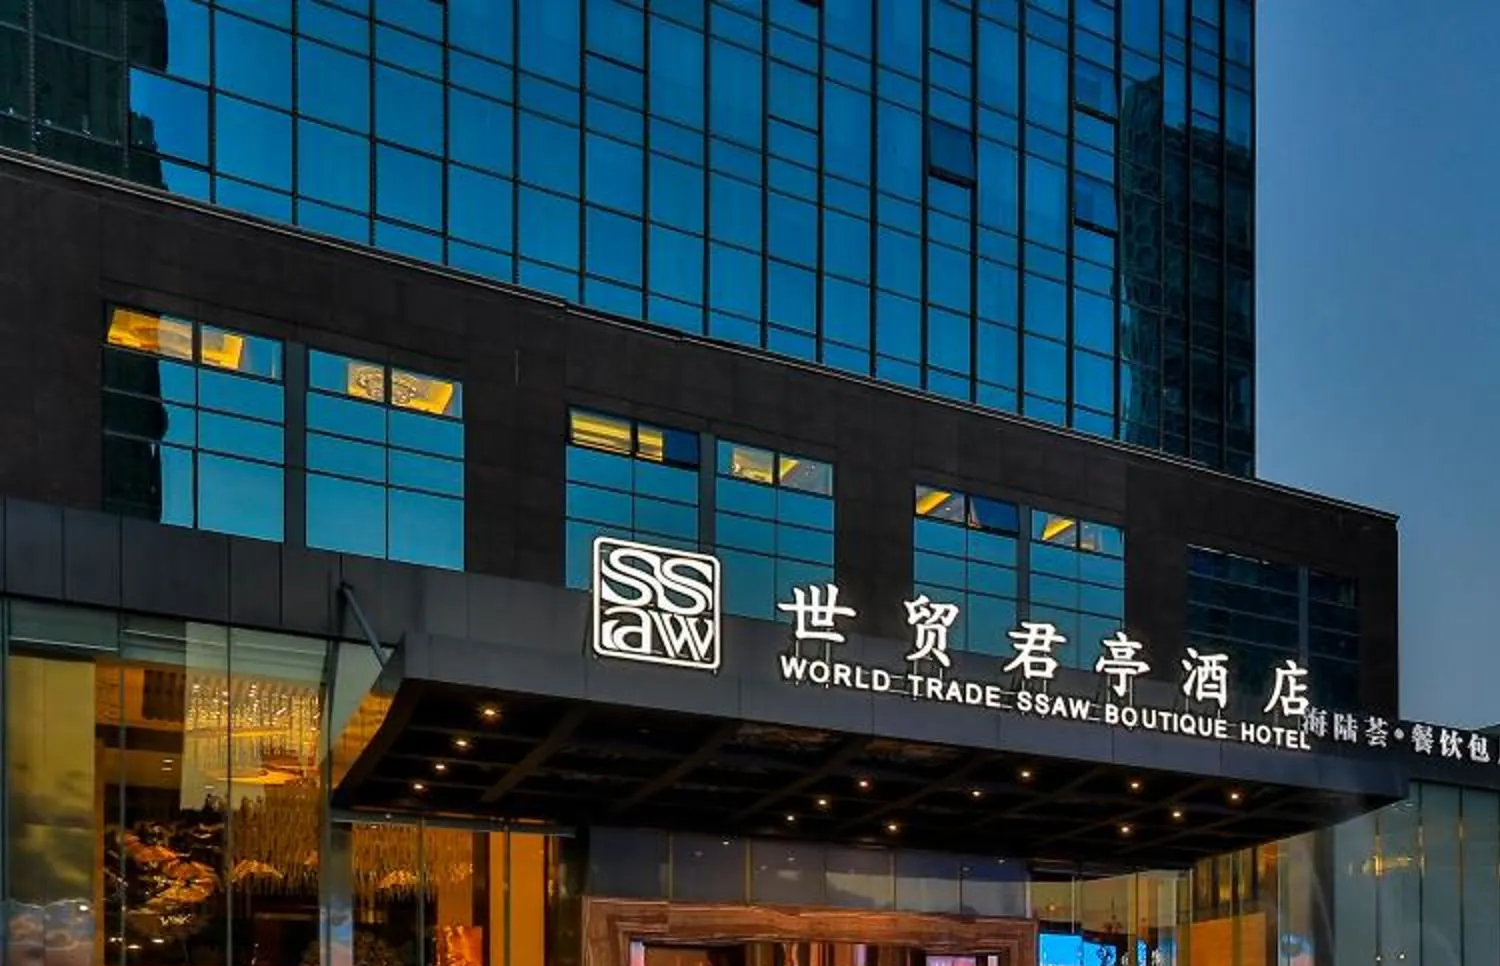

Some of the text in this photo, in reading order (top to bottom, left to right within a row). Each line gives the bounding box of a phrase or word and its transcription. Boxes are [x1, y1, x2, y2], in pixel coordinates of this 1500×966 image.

[777, 583, 1310, 718] 世贸君亭酒店
[780, 654, 1312, 751] WORLD TRADE SSAW BOUTIQUE HOTEL
